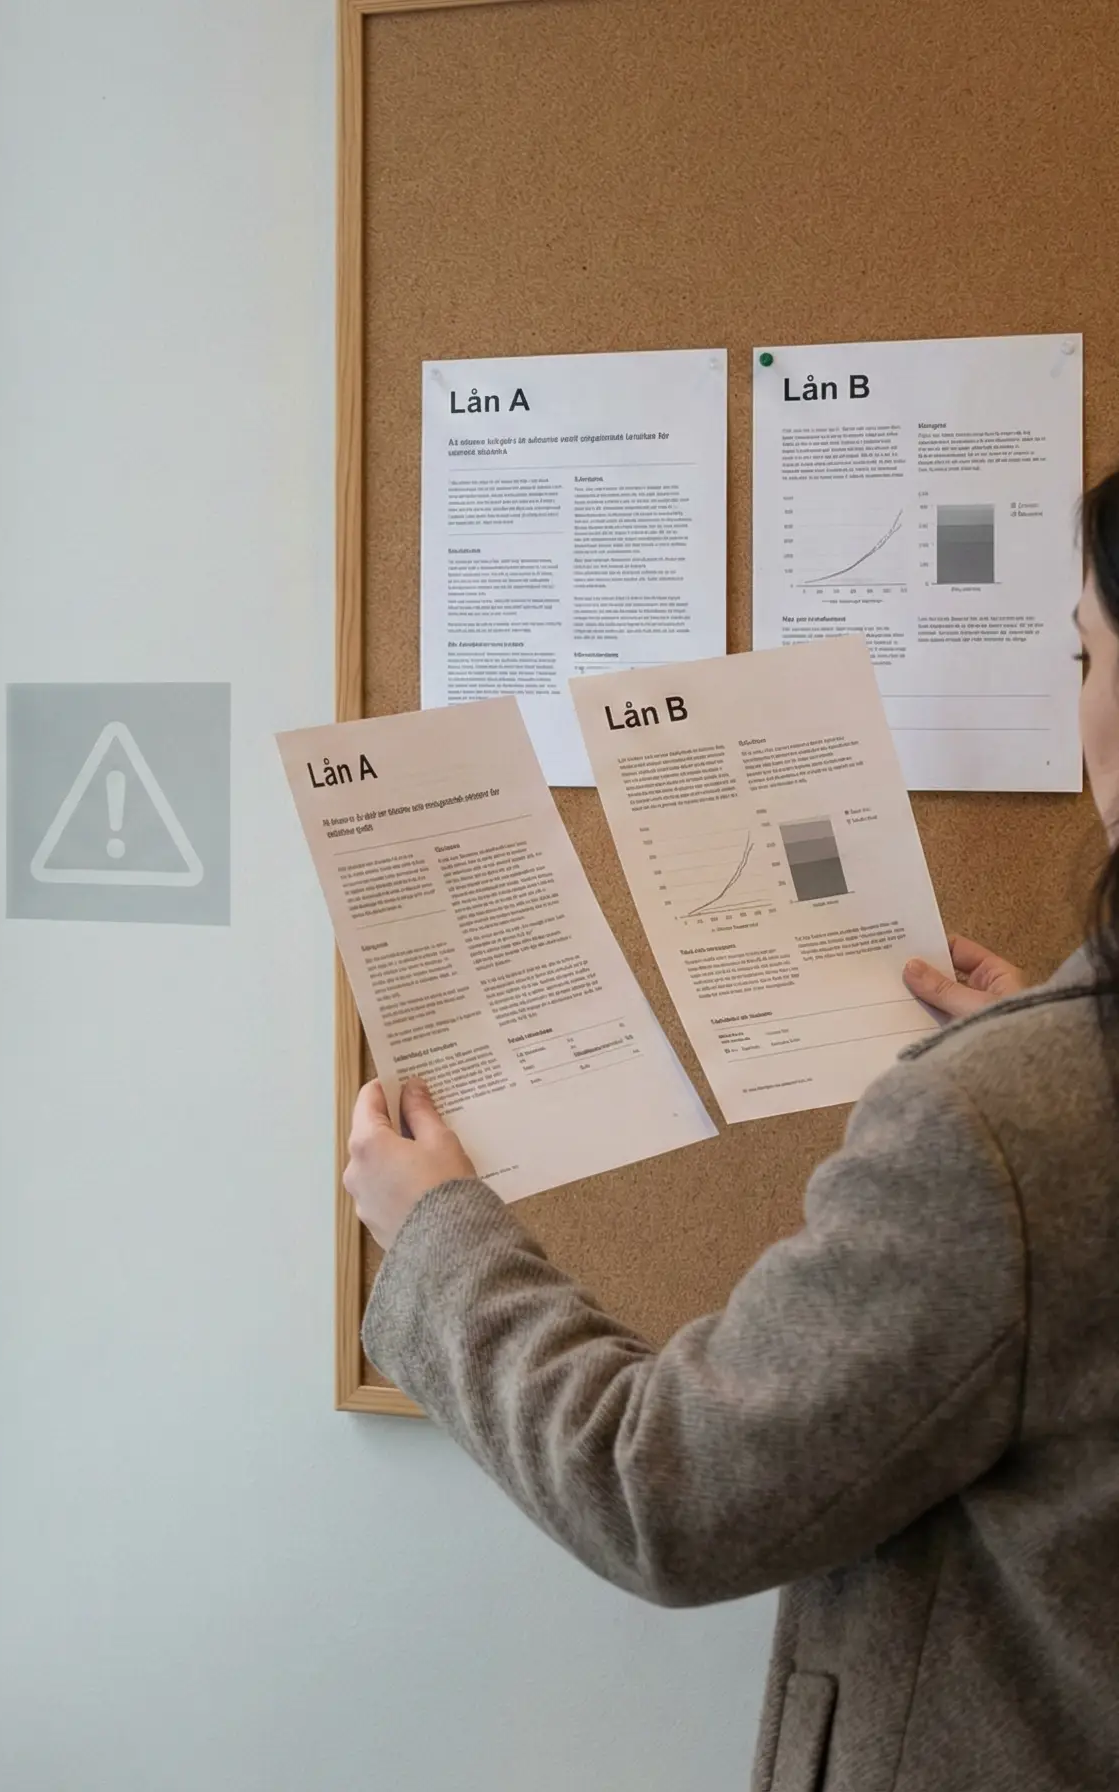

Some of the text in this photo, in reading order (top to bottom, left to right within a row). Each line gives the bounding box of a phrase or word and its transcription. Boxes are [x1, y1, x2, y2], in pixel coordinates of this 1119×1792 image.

[449, 387, 531, 414] Lån A
[783, 374, 871, 402] Lån B
[604, 695, 688, 731] Lån B
[306, 753, 379, 789] Lån A
